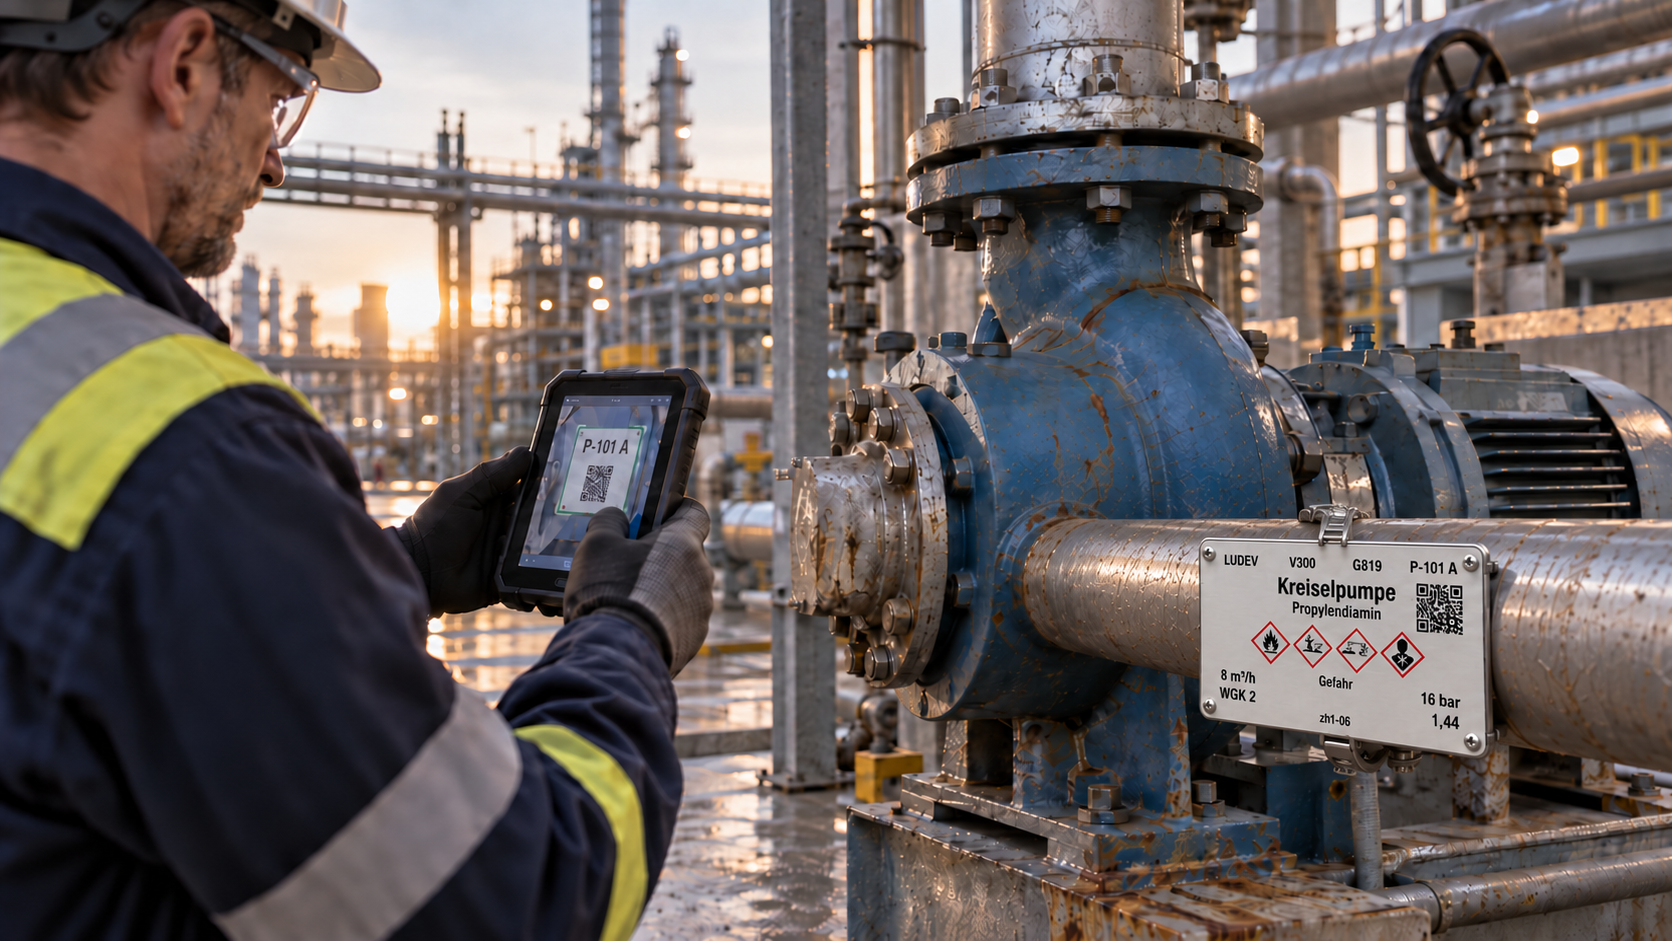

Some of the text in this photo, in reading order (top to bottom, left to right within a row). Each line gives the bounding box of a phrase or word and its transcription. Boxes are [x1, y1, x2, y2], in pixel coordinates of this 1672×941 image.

[582, 438, 629, 455] P-101 A
[1224, 553, 1259, 567] LUDEV
[1289, 556, 1316, 569] V300
[1352, 558, 1383, 572] G819
[1409, 560, 1458, 575] P-101 A
[1277, 576, 1397, 605] Kreiselpumpe
[1292, 601, 1382, 620] Propylendiamin
[1220, 669, 1228, 681] 8
[1318, 675, 1354, 690] Gefahr
[1219, 686, 1256, 703] WGK 2
[1420, 692, 1461, 709] 16 bar
[1319, 713, 1351, 727] zh1-06
[1431, 713, 1460, 730] 1,44
